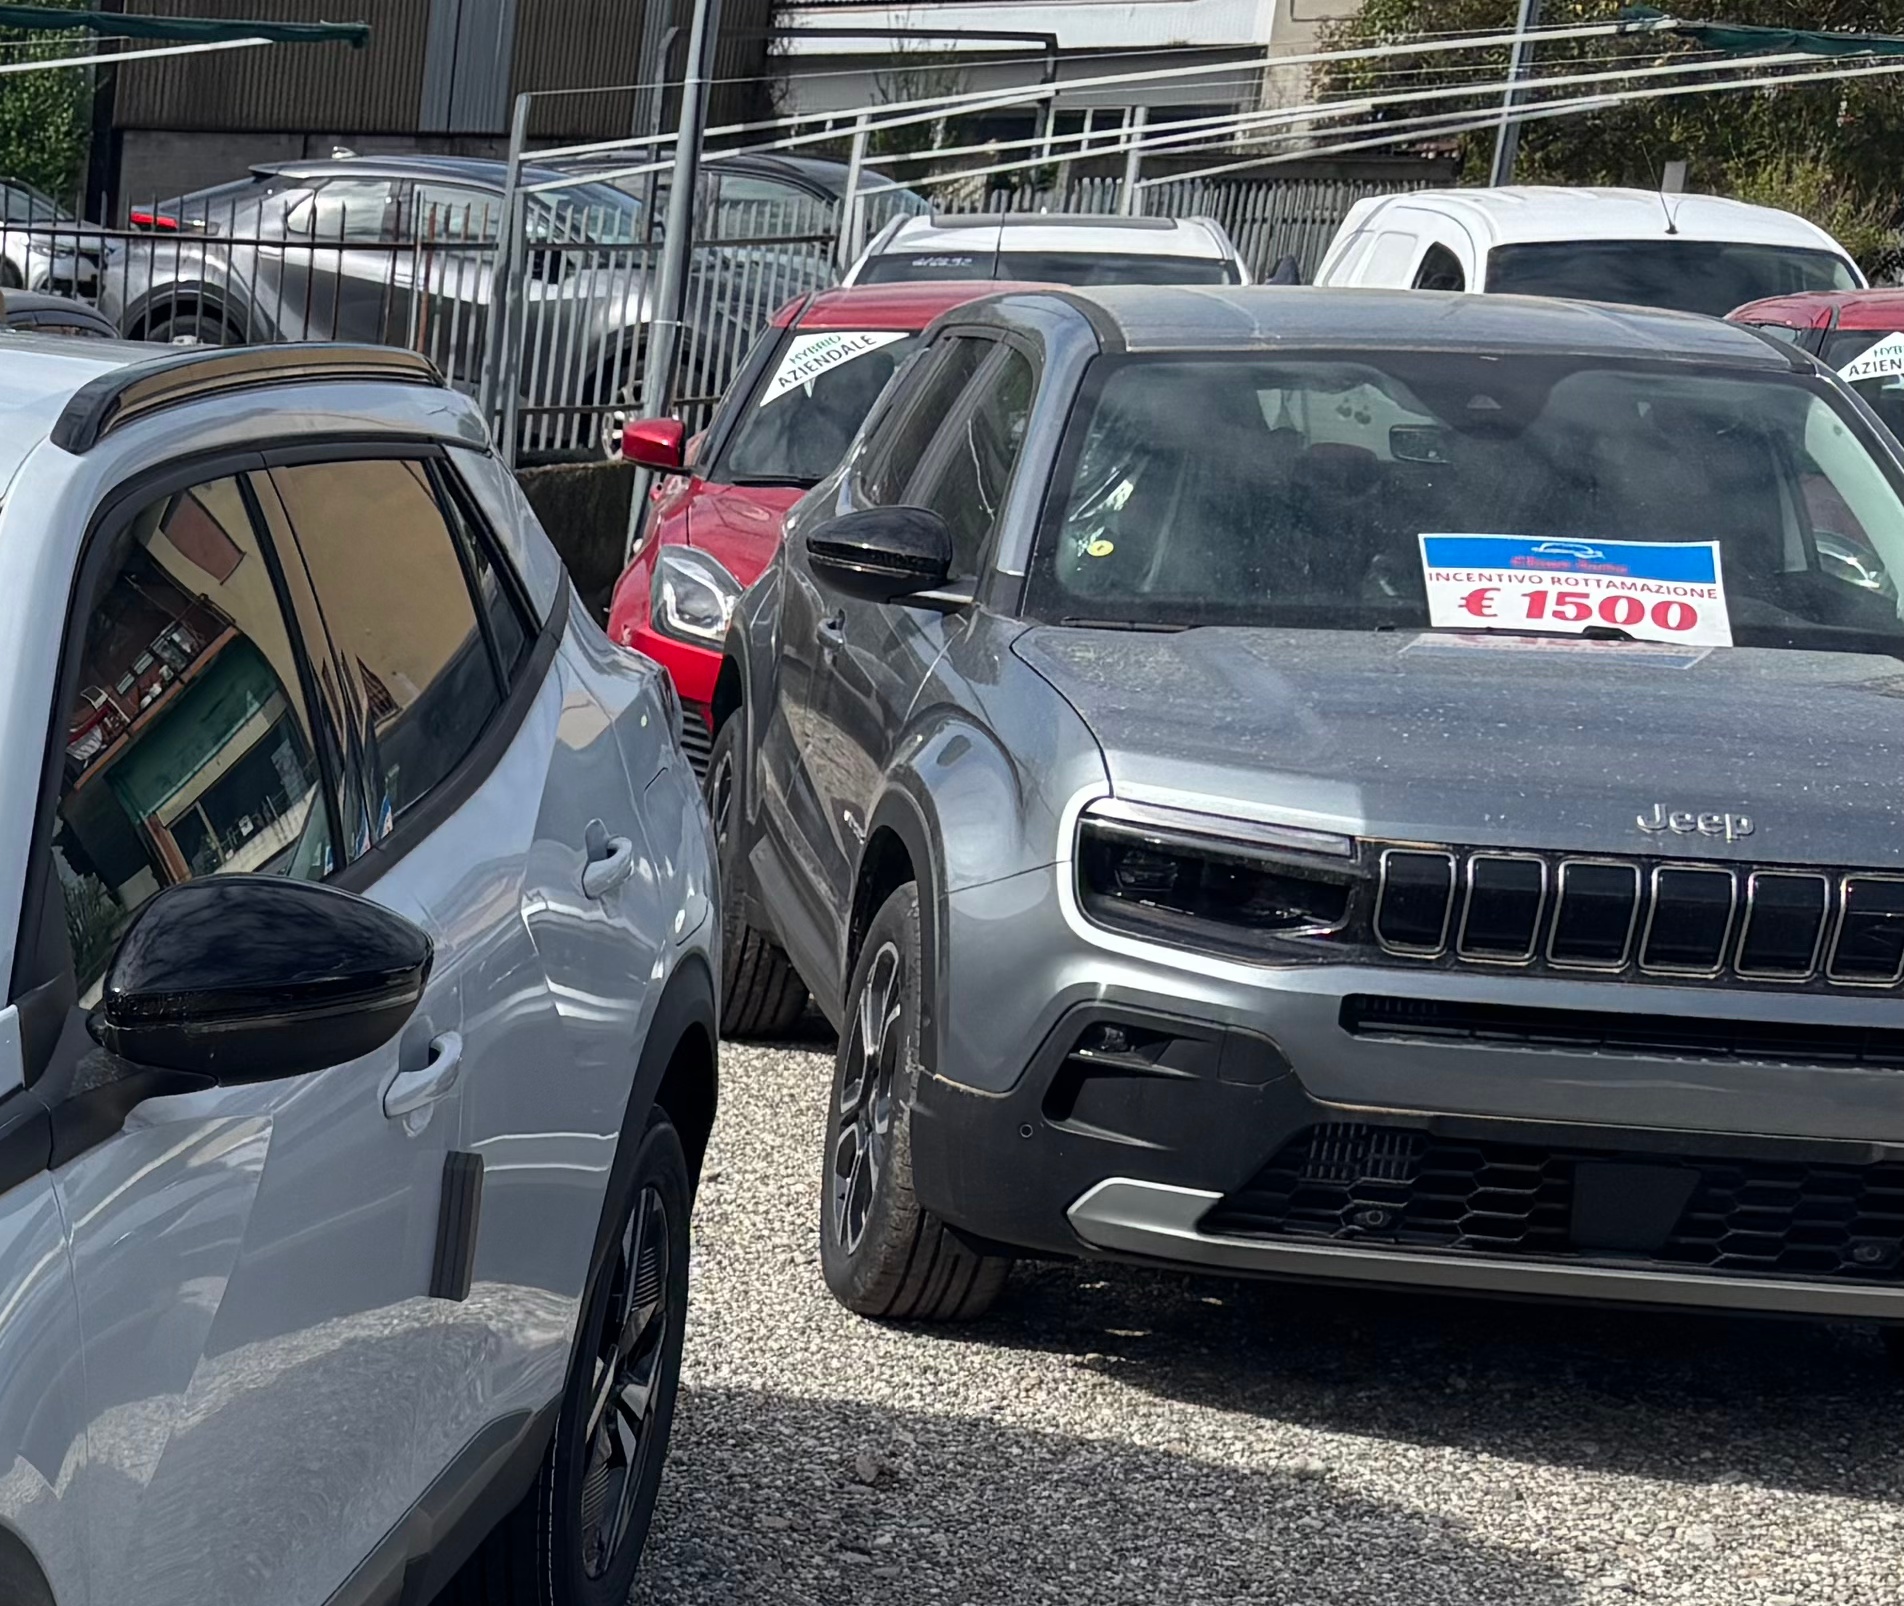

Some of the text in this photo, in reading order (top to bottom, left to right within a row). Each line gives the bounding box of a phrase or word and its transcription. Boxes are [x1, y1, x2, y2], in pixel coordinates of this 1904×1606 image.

[778, 334, 877, 387] AZIENDALE
[1428, 572, 1718, 600] INCENTIVO ROTTAMAZIONE
[1458, 587, 1699, 632] € 1500
[1636, 803, 1756, 843] Jeep
